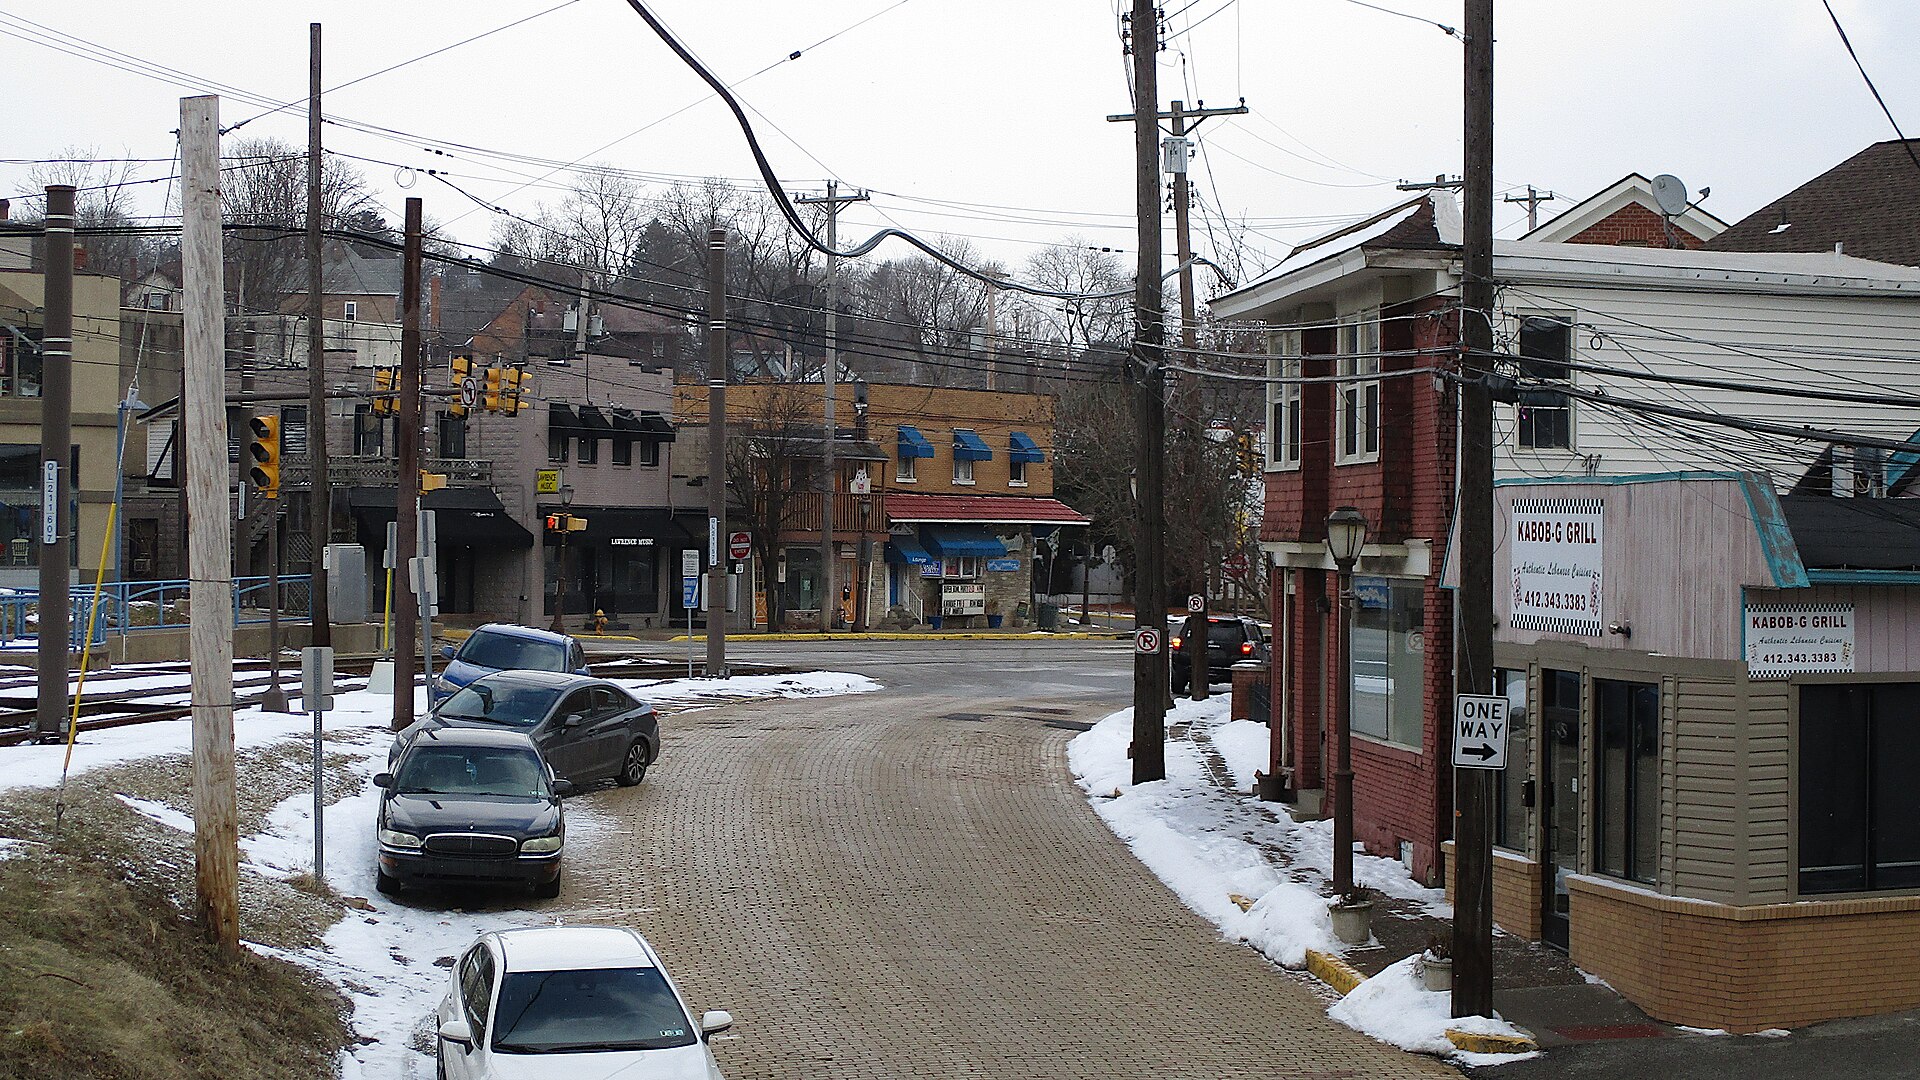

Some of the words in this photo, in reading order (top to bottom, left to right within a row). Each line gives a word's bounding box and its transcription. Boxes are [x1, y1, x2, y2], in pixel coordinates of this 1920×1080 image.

[1517, 520, 1562, 543] KABOB-G
[1566, 521, 1597, 544] GRILL
[638, 538, 654, 546] MUSIC
[1521, 561, 1546, 575] Authentic
[1547, 562, 1570, 576] Lebanese
[1571, 563, 1592, 579] Cuisine
[1524, 590, 1586, 611] 412.343.3383
[1752, 615, 1807, 629] KABOB-G
[1811, 615, 1847, 628] GRILL
[1758, 636, 1788, 645] Authentic
[1789, 636, 1817, 644] Lebanese
[1819, 635, 1843, 645] Cuisine
[1763, 652, 1837, 664] 412.343.3383
[1463, 701, 1503, 720] ONE
[1460, 720, 1503, 739] WAY
